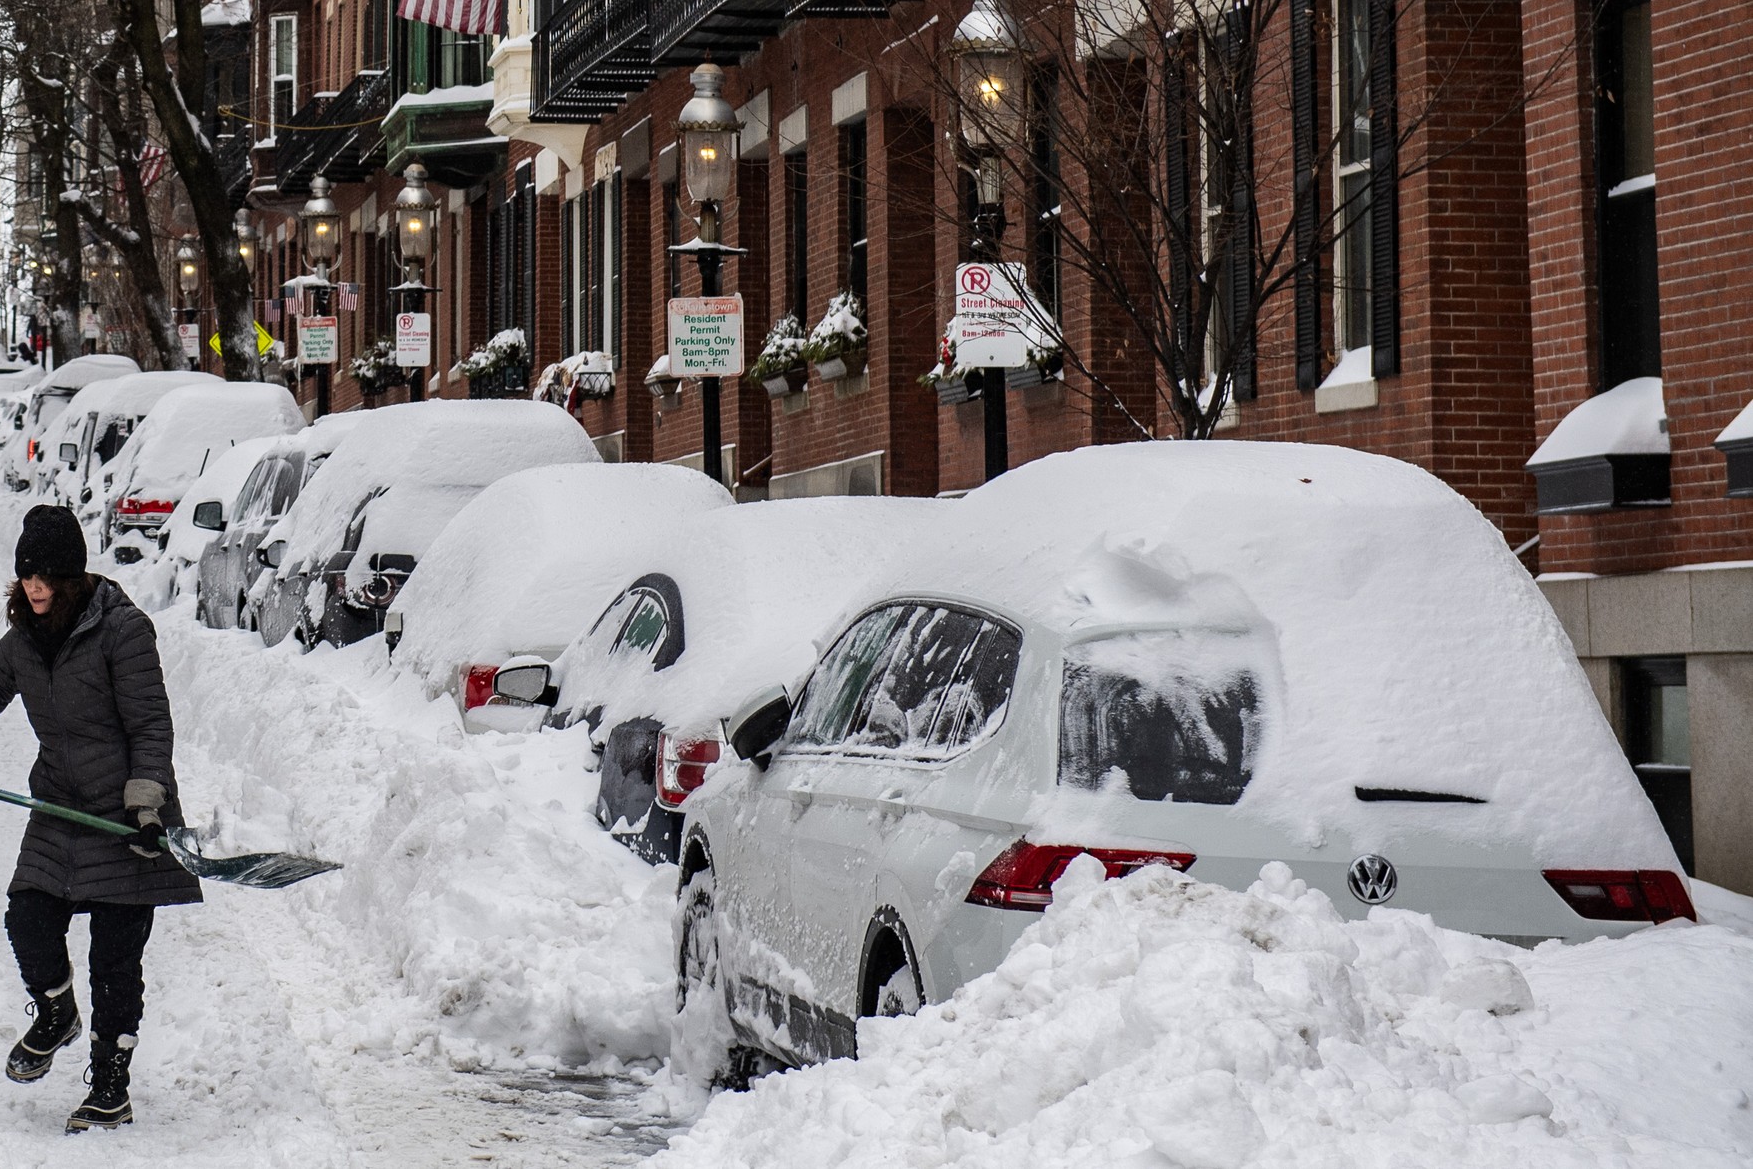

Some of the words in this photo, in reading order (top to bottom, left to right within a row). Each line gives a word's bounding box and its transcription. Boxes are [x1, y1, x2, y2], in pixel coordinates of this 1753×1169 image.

[961, 297, 986, 309] Street
[990, 297, 1024, 310] Cleaning
[684, 314, 726, 324] Resident
[690, 325, 720, 334] Permit
[675, 336, 711, 347] Parking
[714, 335, 736, 346] Only
[682, 347, 730, 357] 8am-8pm
[684, 358, 727, 368] Mon.-Fri.
